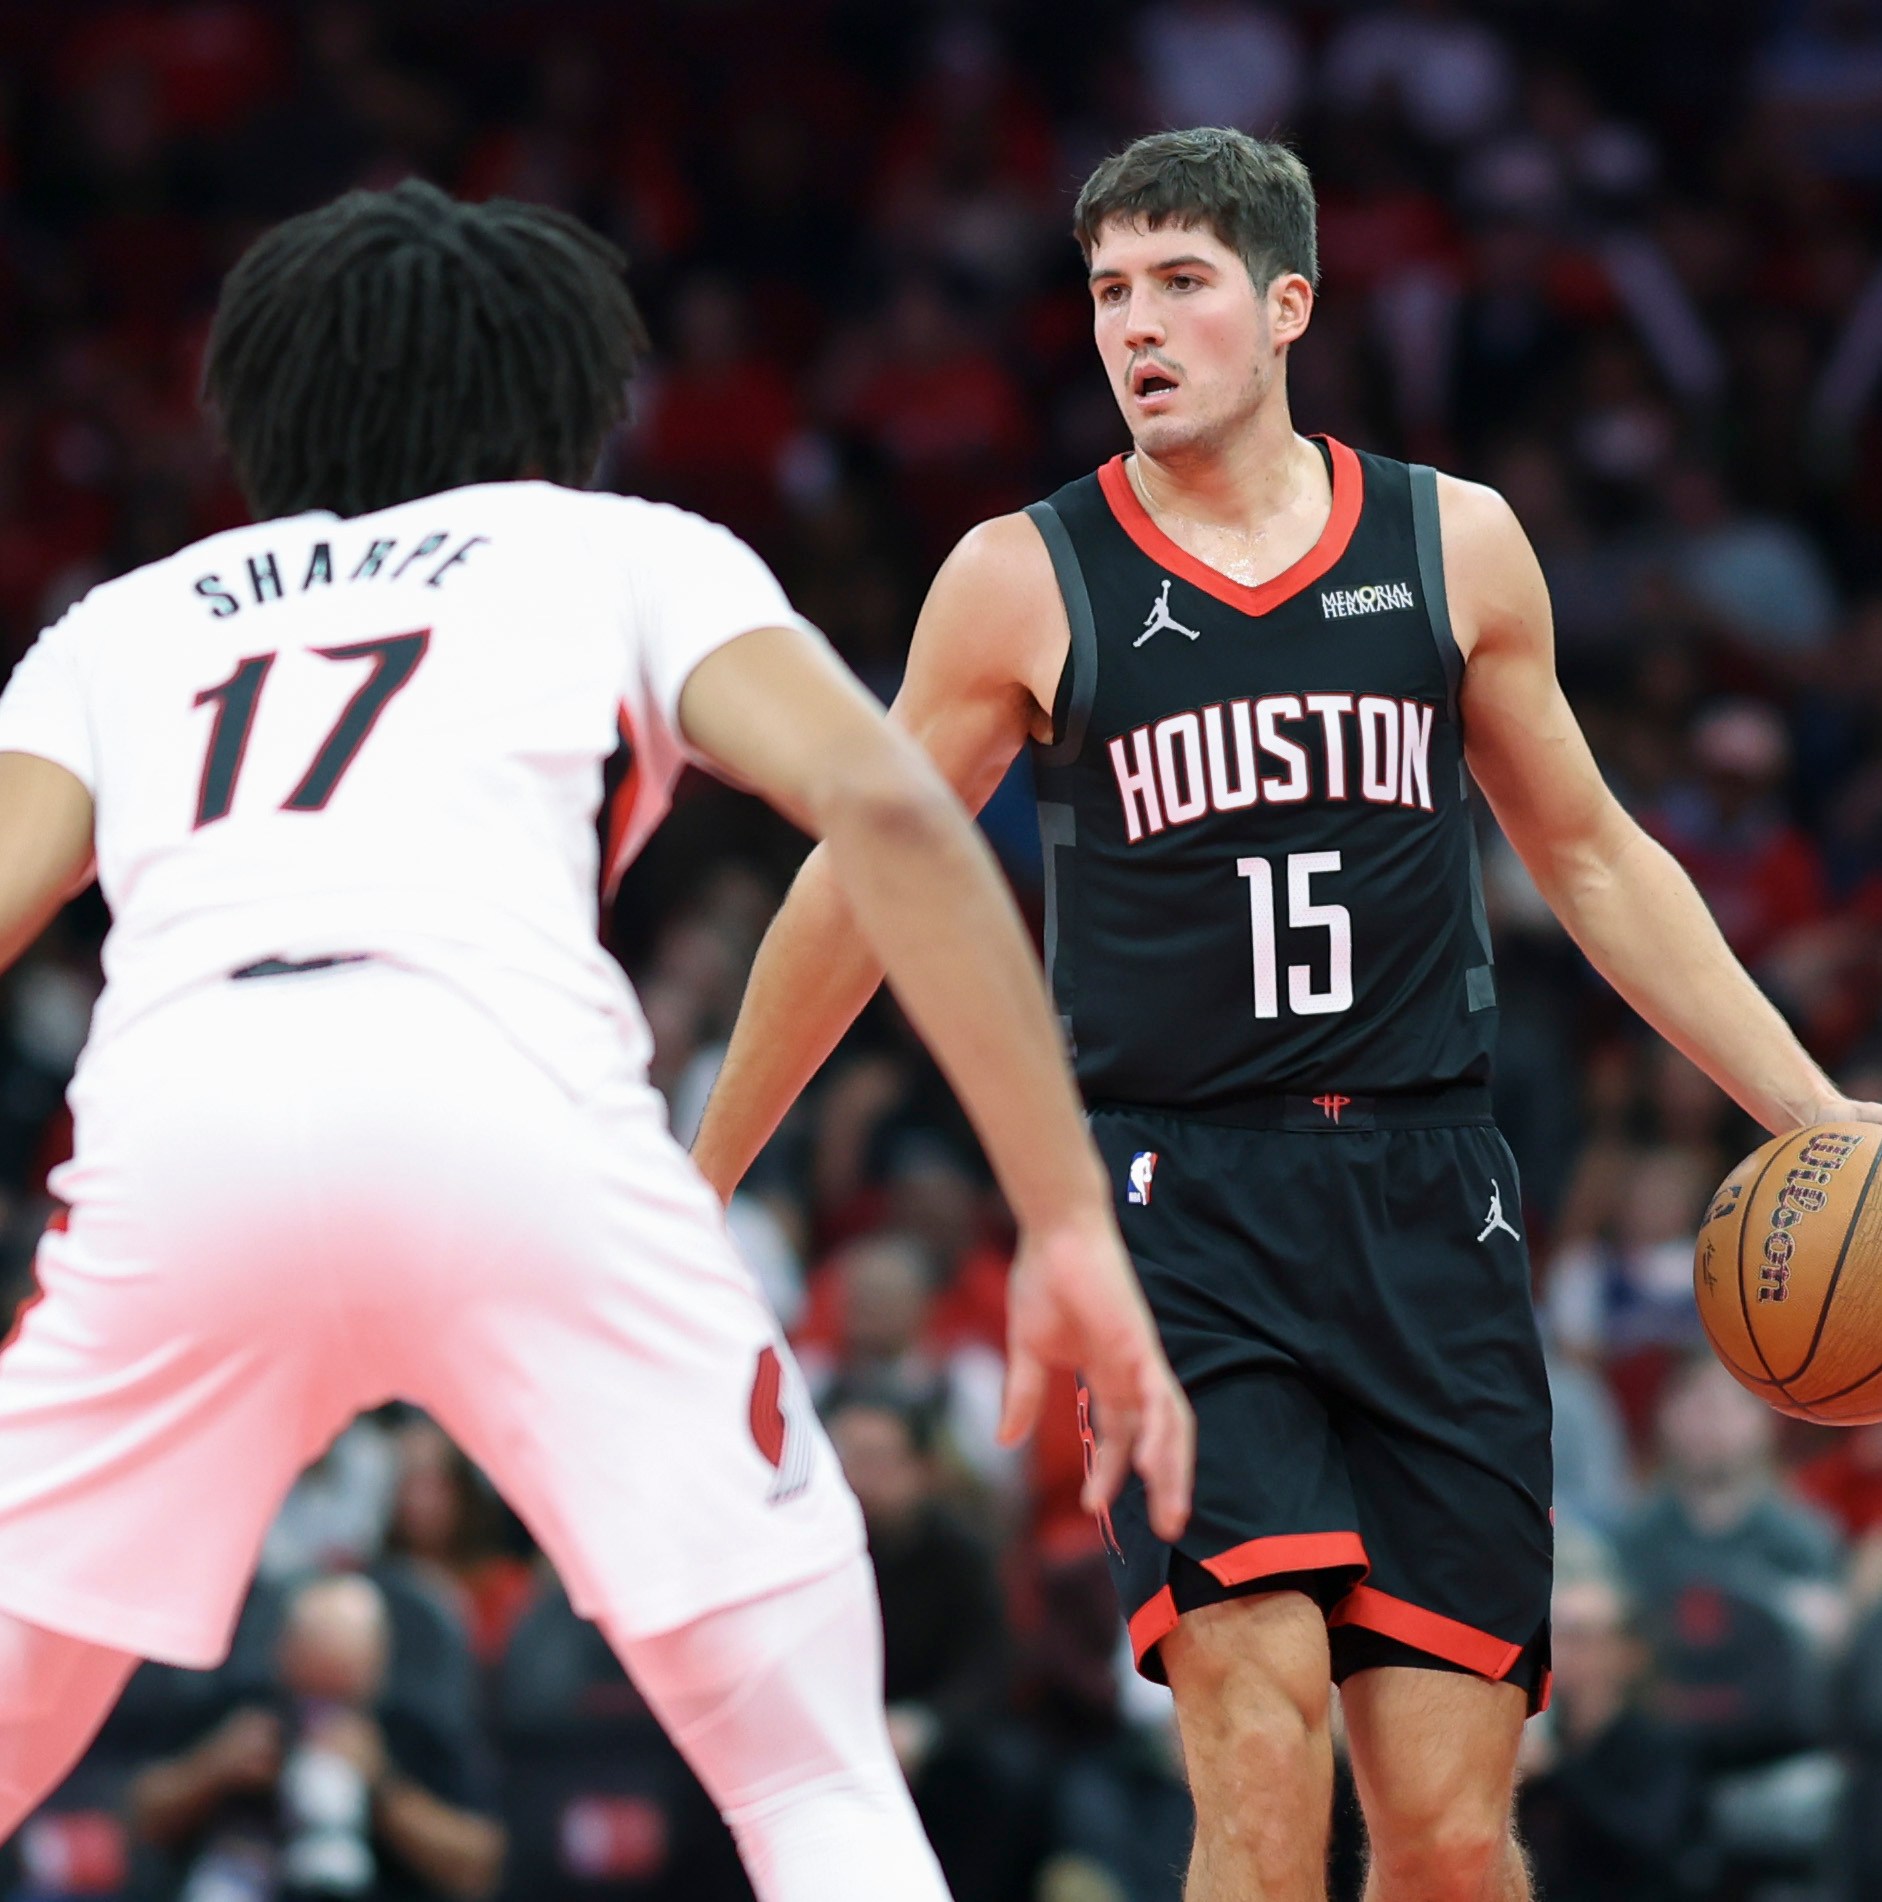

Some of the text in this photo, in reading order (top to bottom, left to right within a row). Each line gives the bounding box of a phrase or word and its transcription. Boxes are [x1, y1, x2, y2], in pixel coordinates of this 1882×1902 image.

[193, 531, 491, 617] SHARPE
[1321, 582, 1412, 606] MEMORIAL
[1323, 593, 1414, 619] HERMANN
[192, 627, 433, 832] 17
[1107, 692, 1434, 845] HOUSTON
[1236, 850, 1354, 1018] 15
[1758, 1132, 1865, 1304] Wilson
